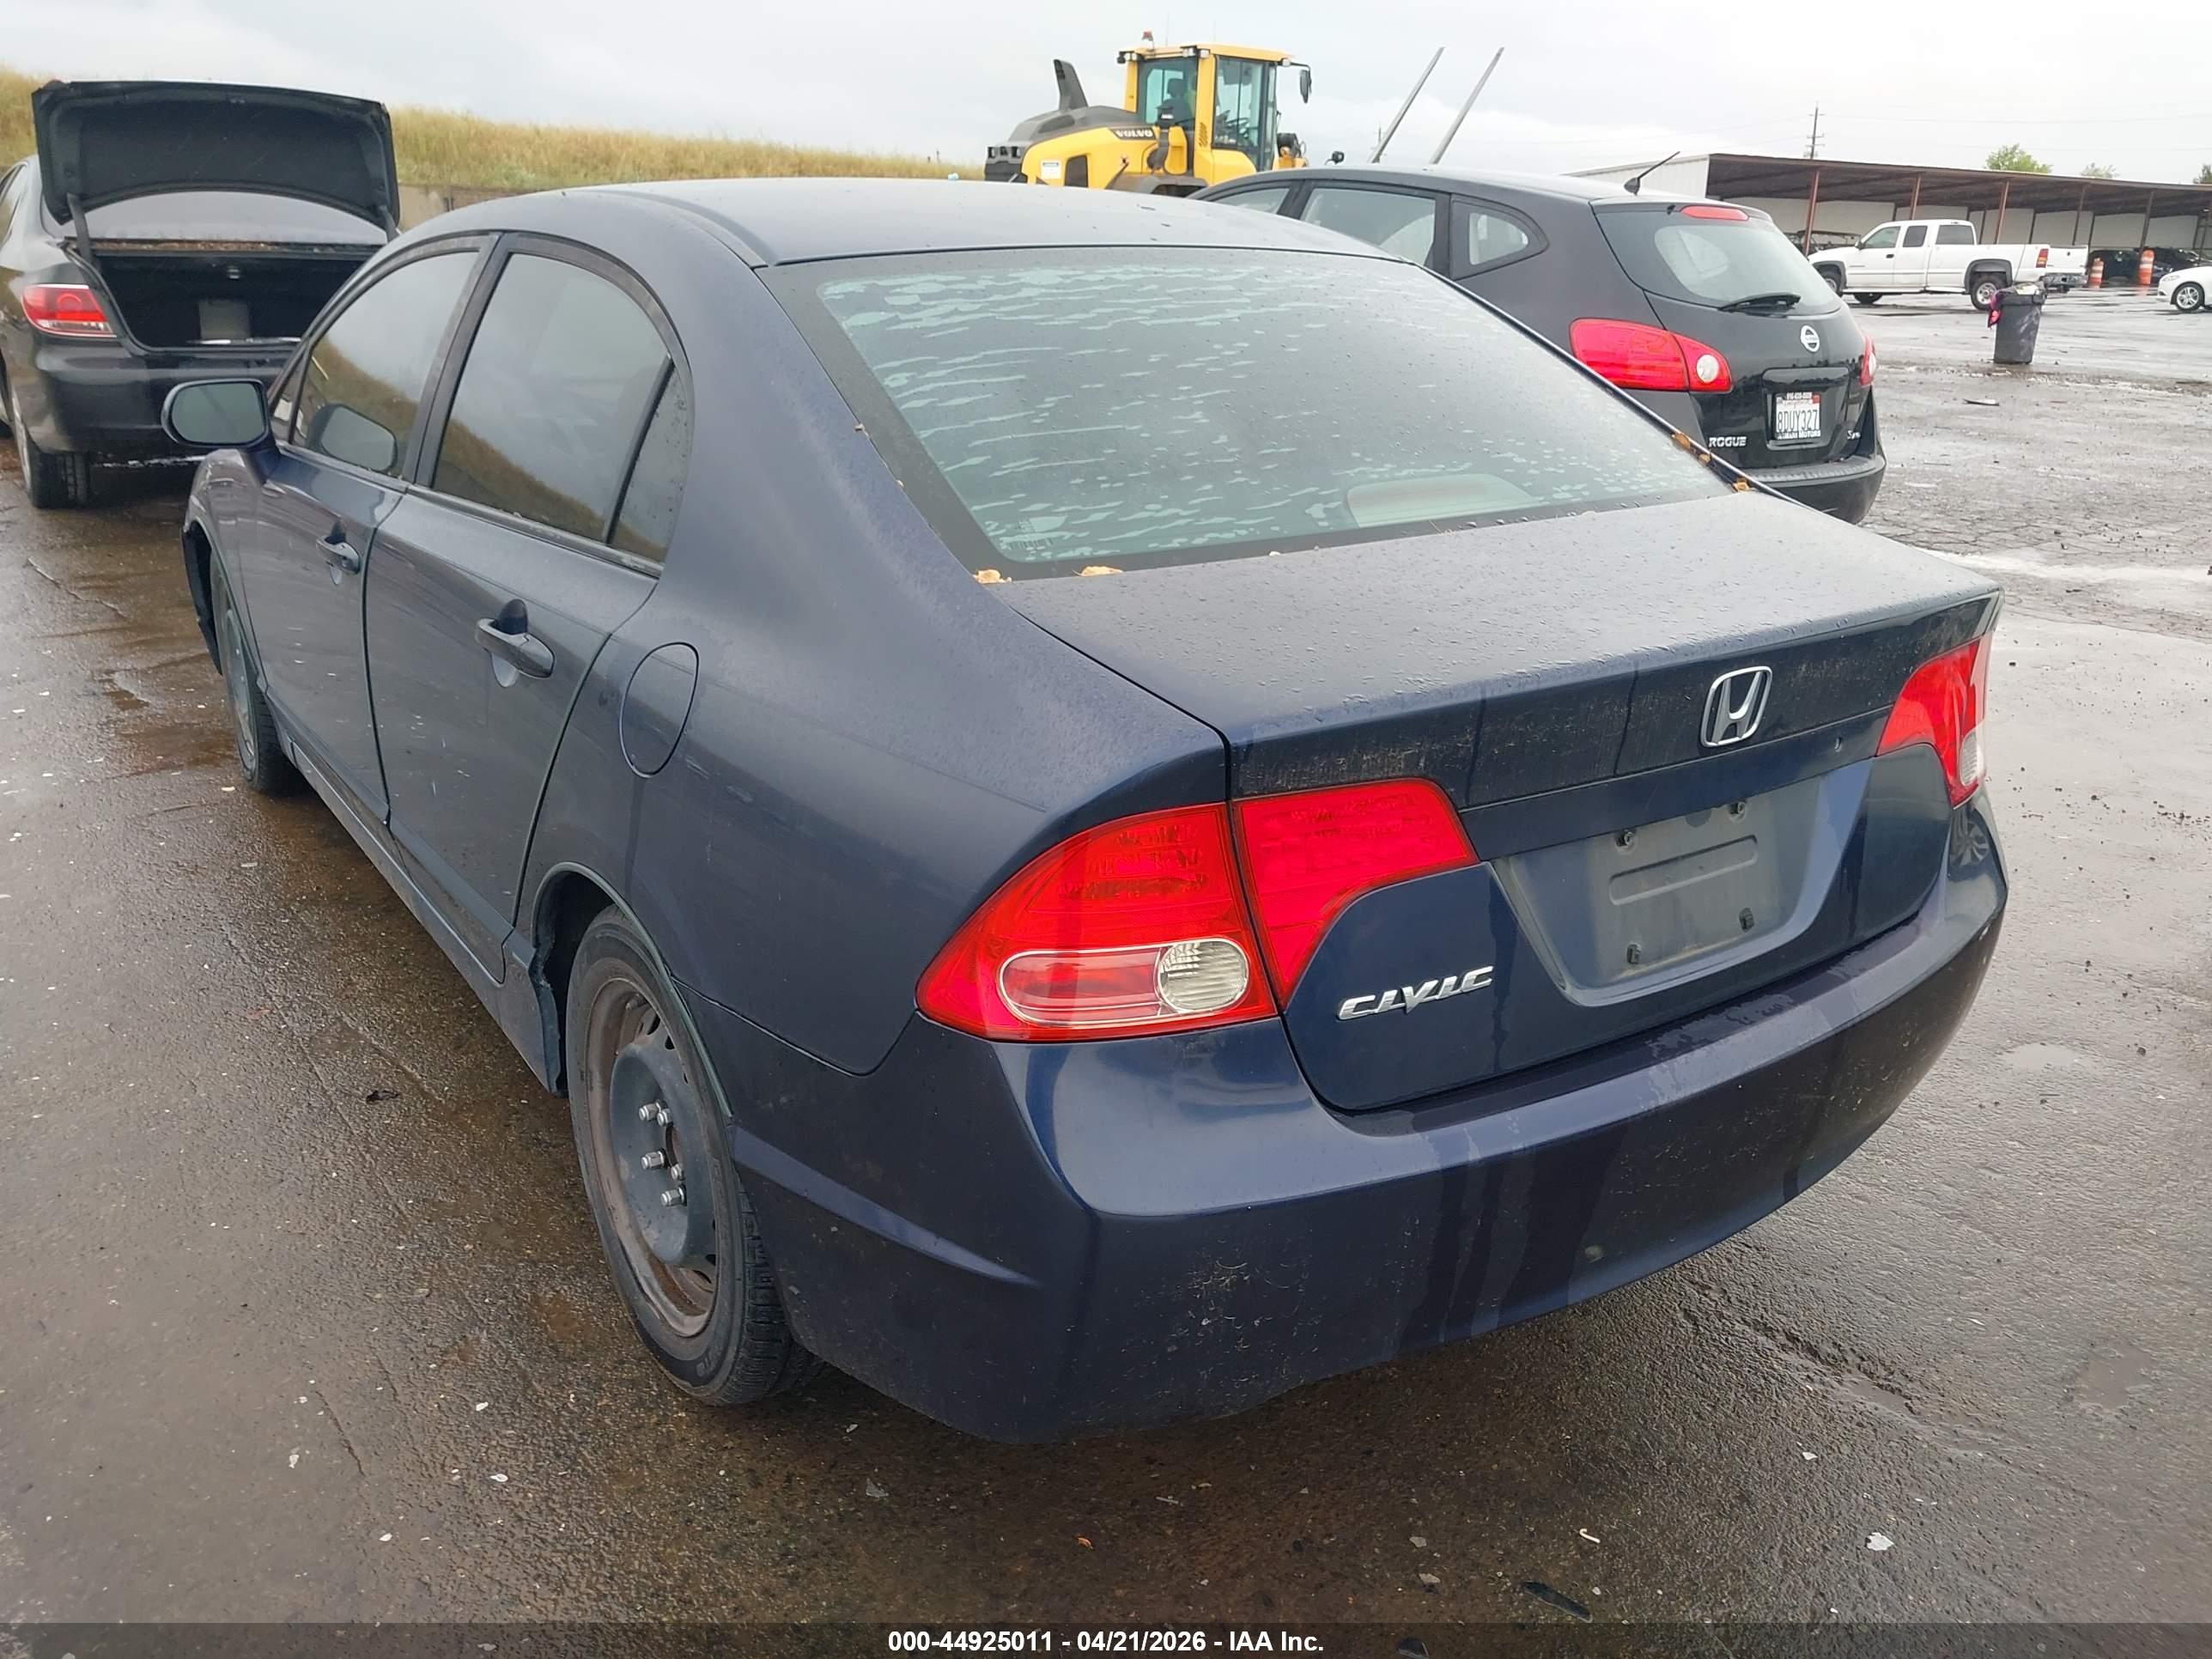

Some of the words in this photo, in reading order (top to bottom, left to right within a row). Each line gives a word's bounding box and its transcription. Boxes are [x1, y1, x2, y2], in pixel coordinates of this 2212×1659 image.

[1777, 410, 1818, 433] 8DUY327
[1709, 436, 1747, 447] ROGUE
[1338, 965, 1494, 1021] CIVIC
